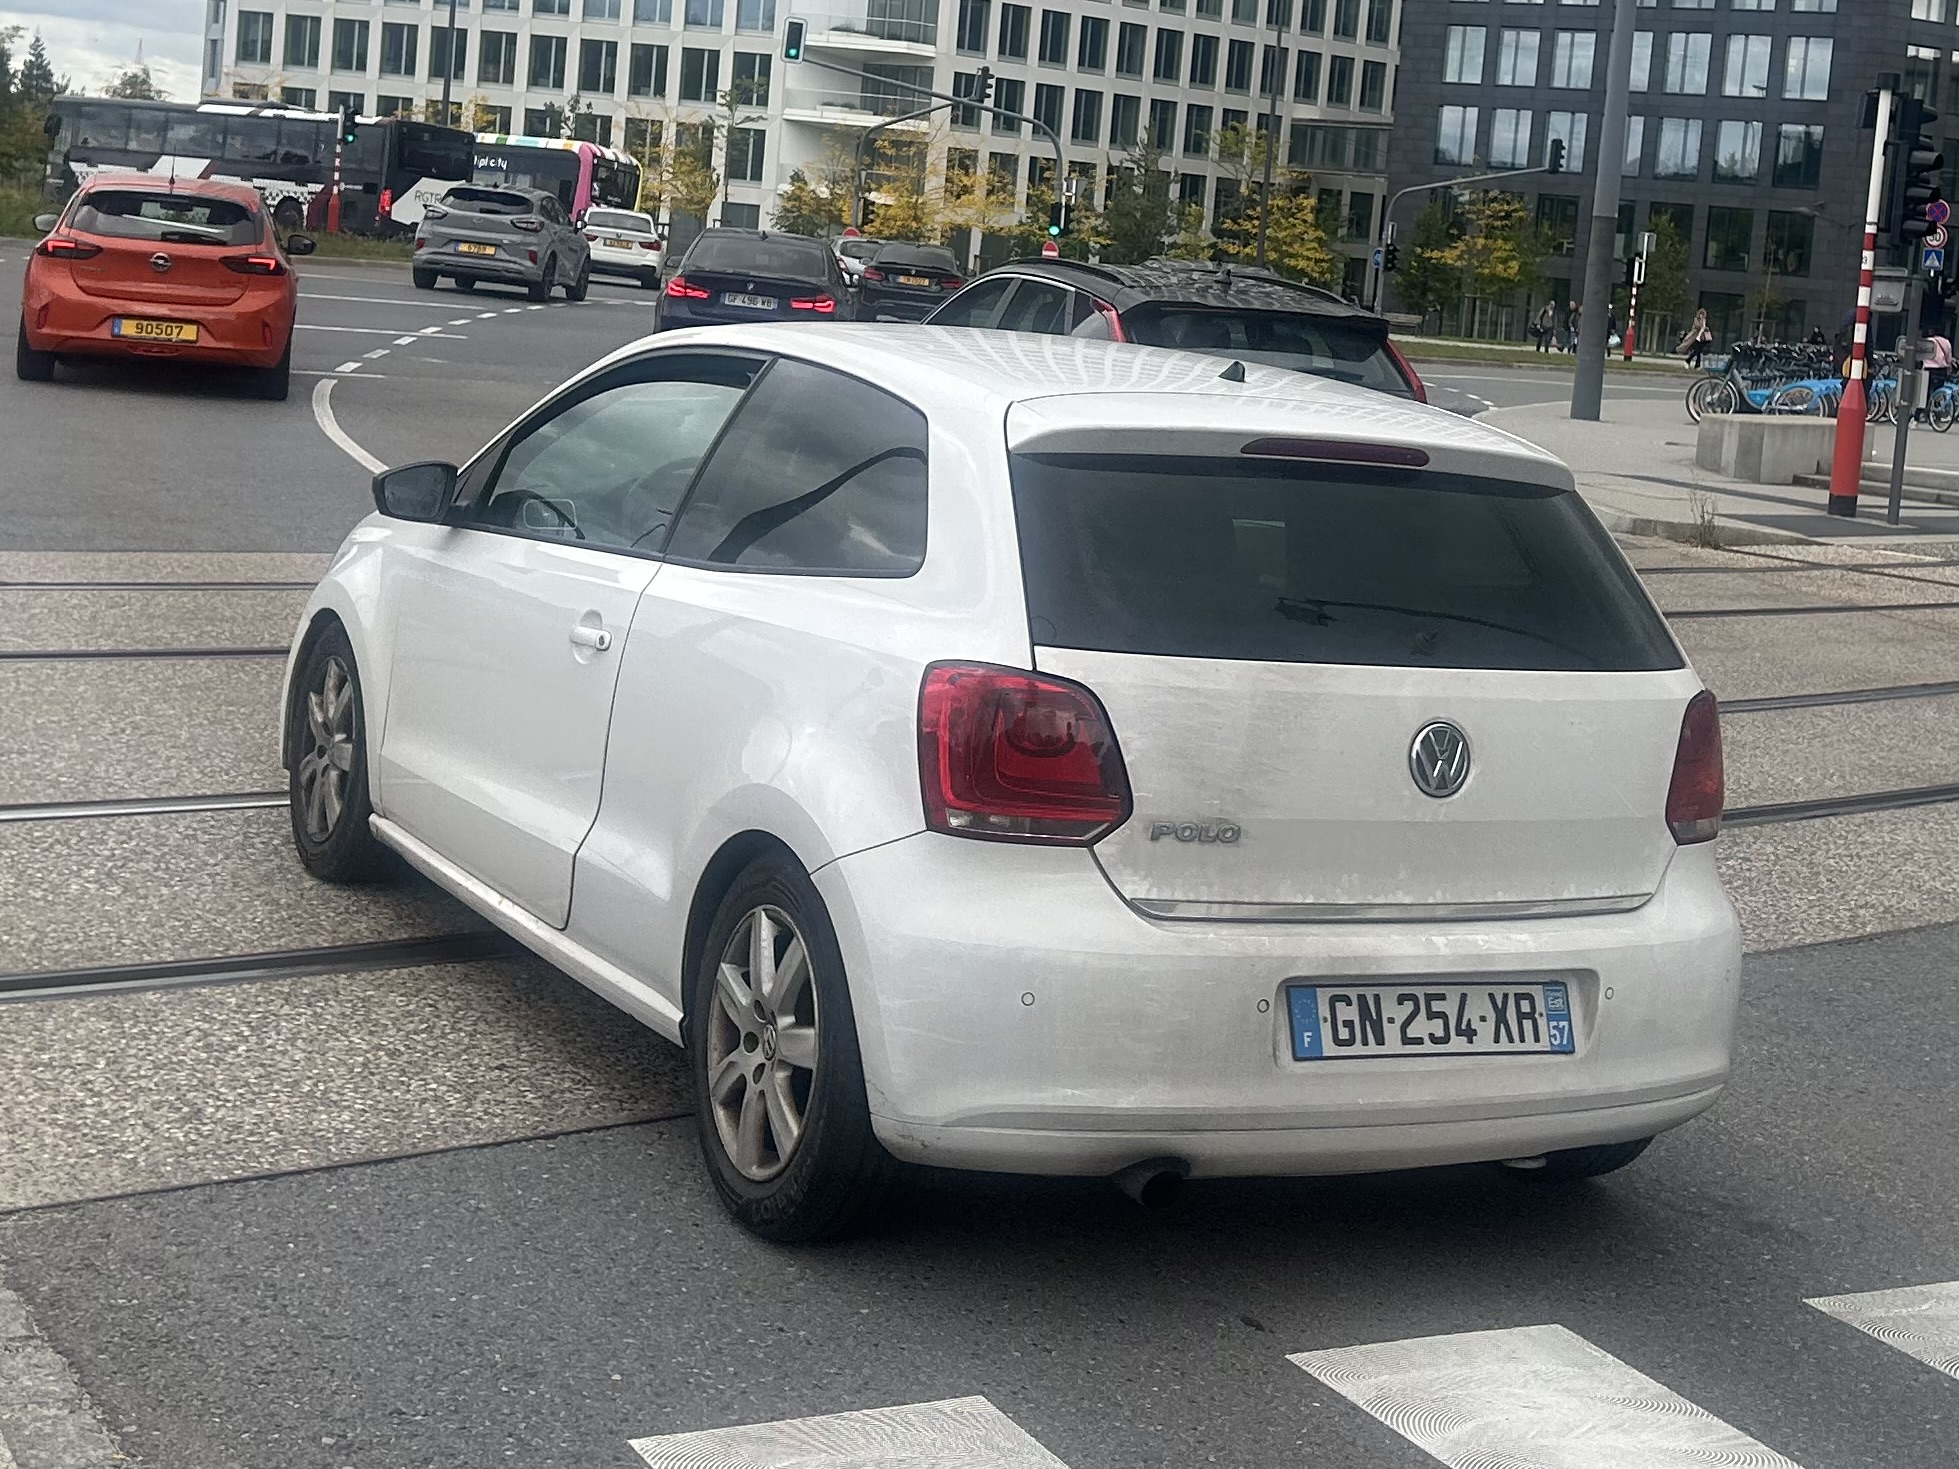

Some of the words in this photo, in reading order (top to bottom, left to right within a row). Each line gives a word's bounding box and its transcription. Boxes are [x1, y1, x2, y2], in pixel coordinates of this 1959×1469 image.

[134, 322, 184, 337] 90507
[1150, 821, 1241, 844] POLO
[1328, 992, 1541, 1047] GN-254-XR
[1302, 1031, 1313, 1048] F
[1548, 1020, 1570, 1046] 57
